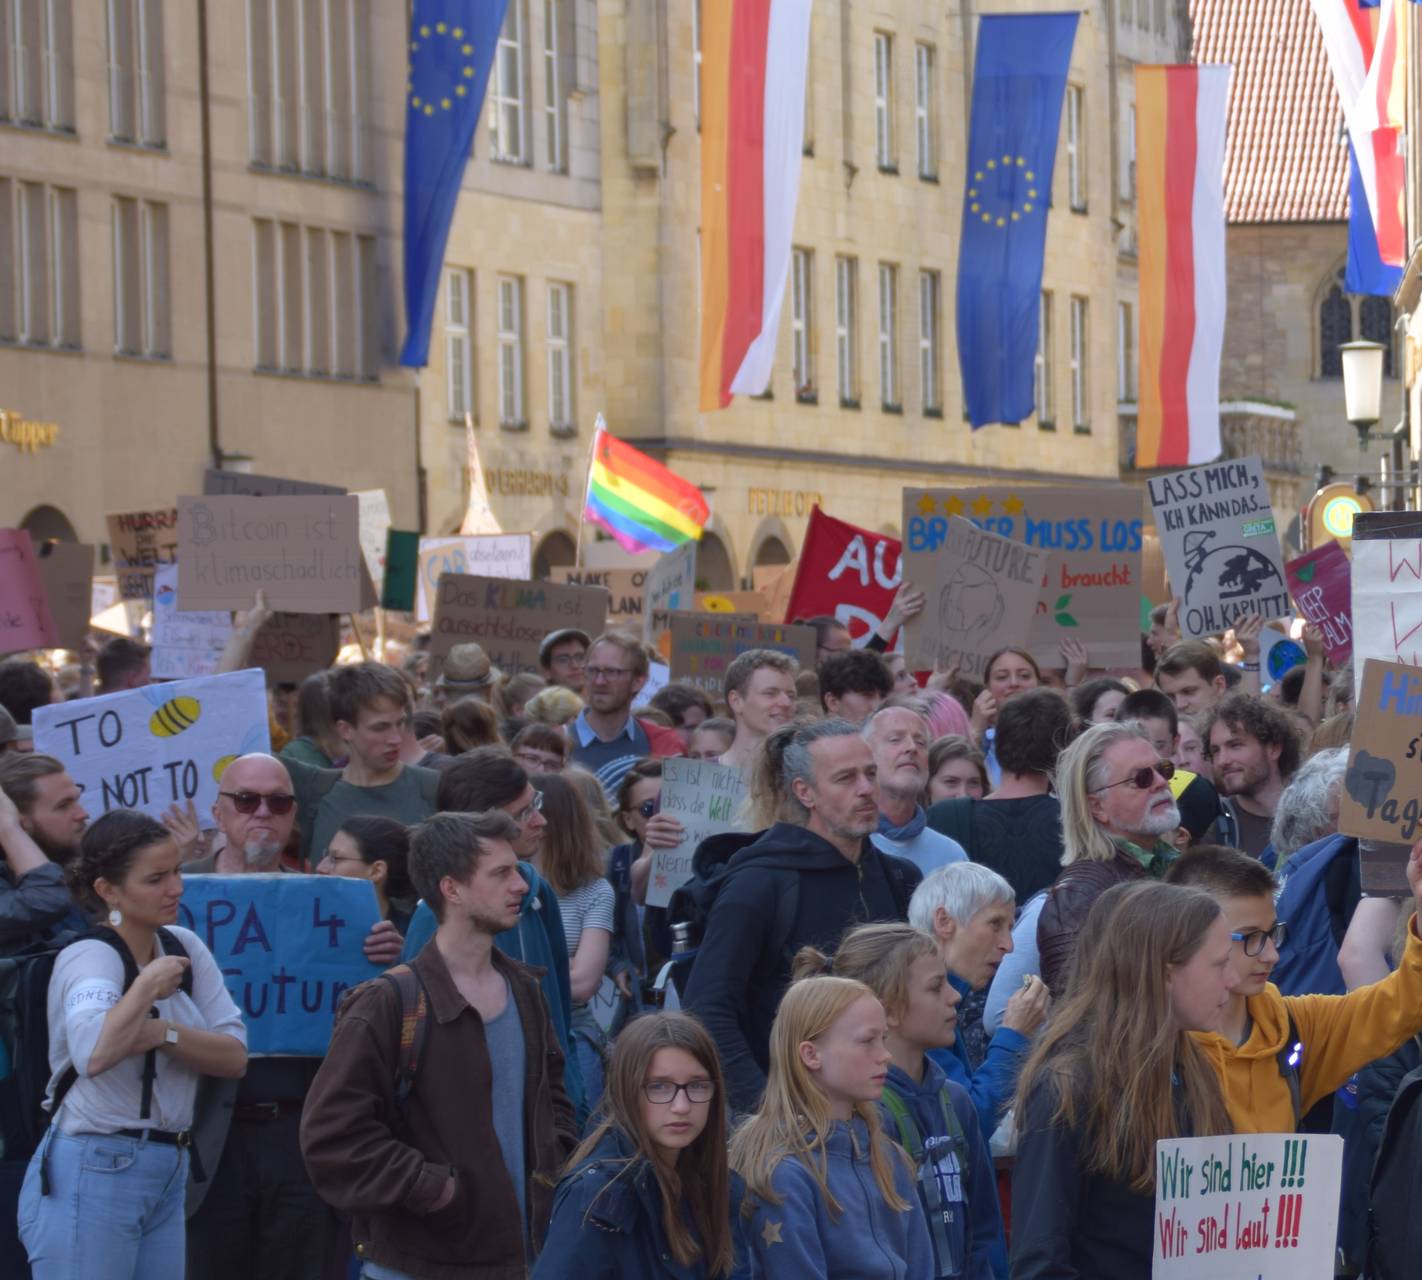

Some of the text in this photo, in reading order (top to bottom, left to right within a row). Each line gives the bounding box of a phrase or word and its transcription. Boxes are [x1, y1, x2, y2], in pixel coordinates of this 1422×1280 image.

[1148, 464, 1259, 507] LASS MICH,
[189, 504, 288, 547] Bitcoin
[305, 503, 338, 542] ist
[1024, 511, 1094, 551] MUSS
[1101, 519, 1143, 551] LOS
[1163, 508, 1184, 532] ICH
[439, 580, 478, 608] Das
[1061, 563, 1133, 590] braucht
[54, 709, 122, 756] TO
[102, 759, 200, 811] NOT TO
[712, 767, 743, 795] nicht
[312, 897, 347, 949] 4
[1160, 1139, 1308, 1201] Wir sind hier !!!
[1159, 1193, 1303, 1260] Wir sind laut !!!
